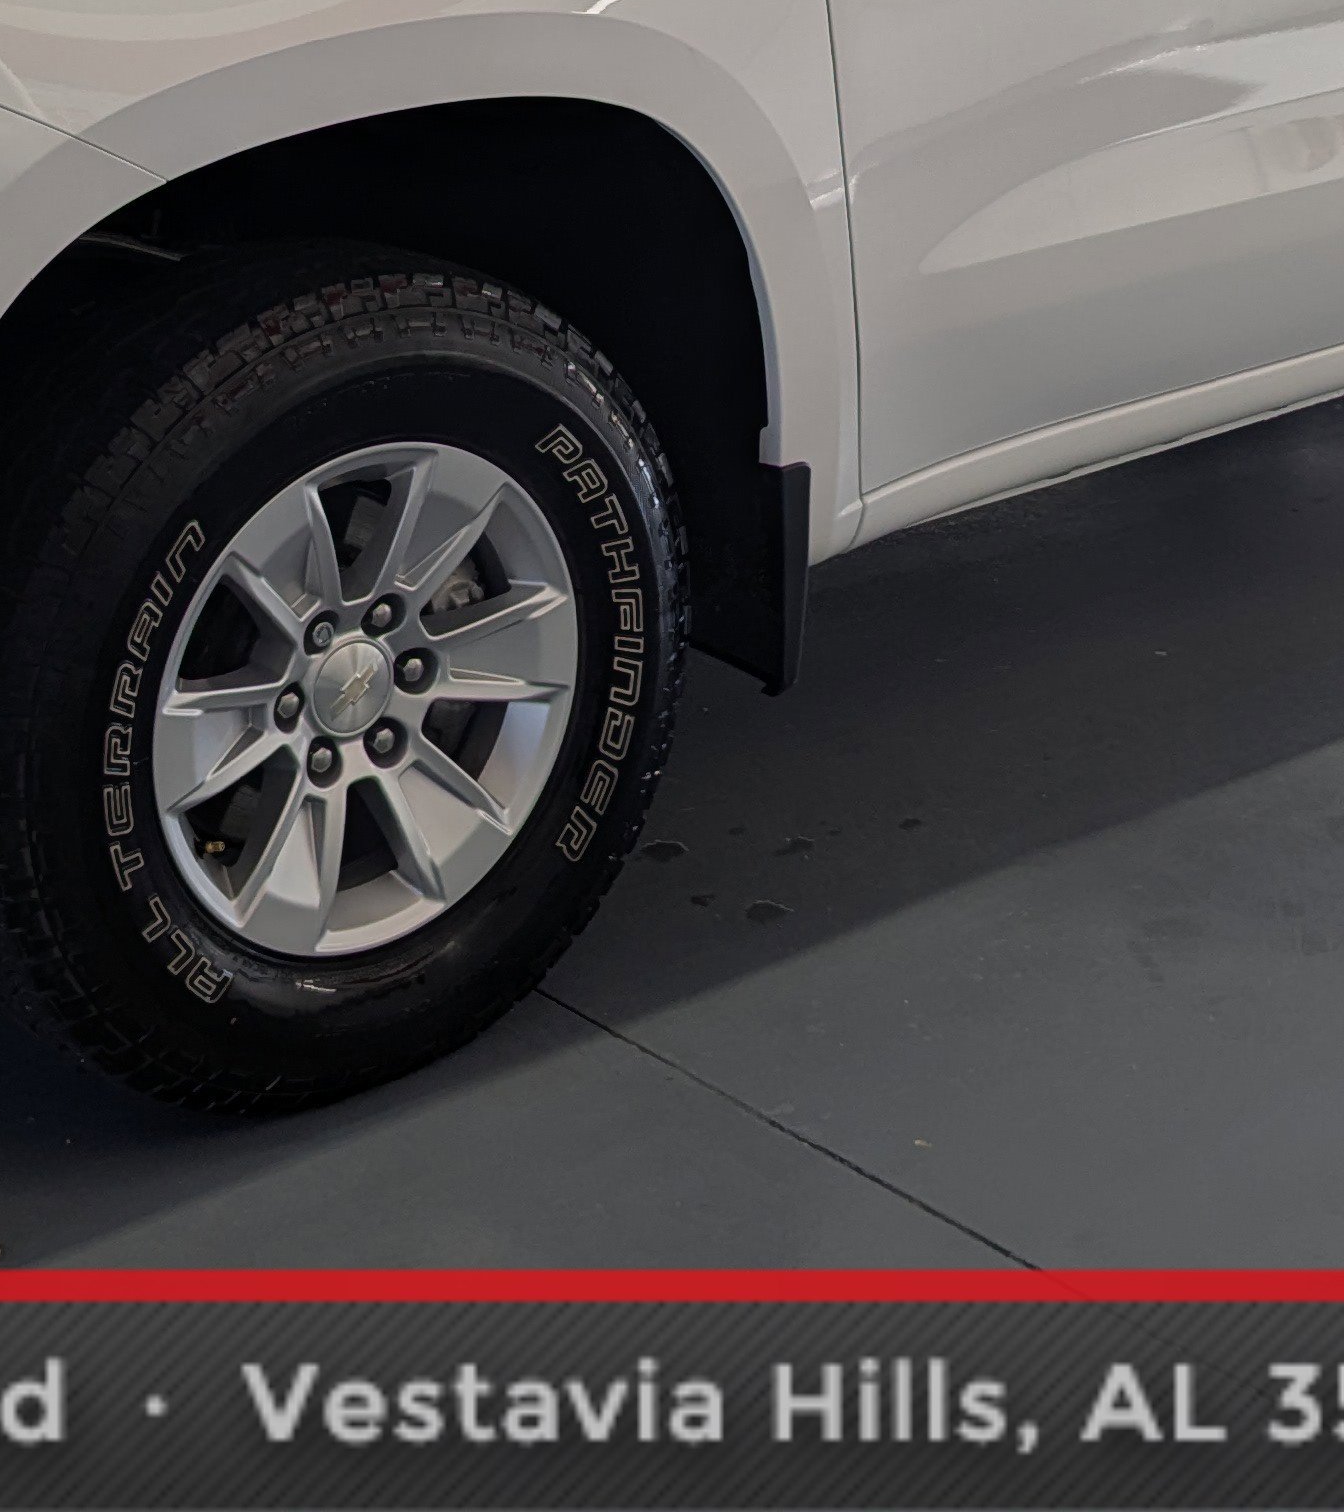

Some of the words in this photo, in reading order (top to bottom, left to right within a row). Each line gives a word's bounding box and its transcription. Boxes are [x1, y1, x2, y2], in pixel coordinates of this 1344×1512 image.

[102, 519, 206, 892] TERRAIN
[535, 422, 646, 864] PATHFINDER
[141, 894, 235, 1005] ALL
